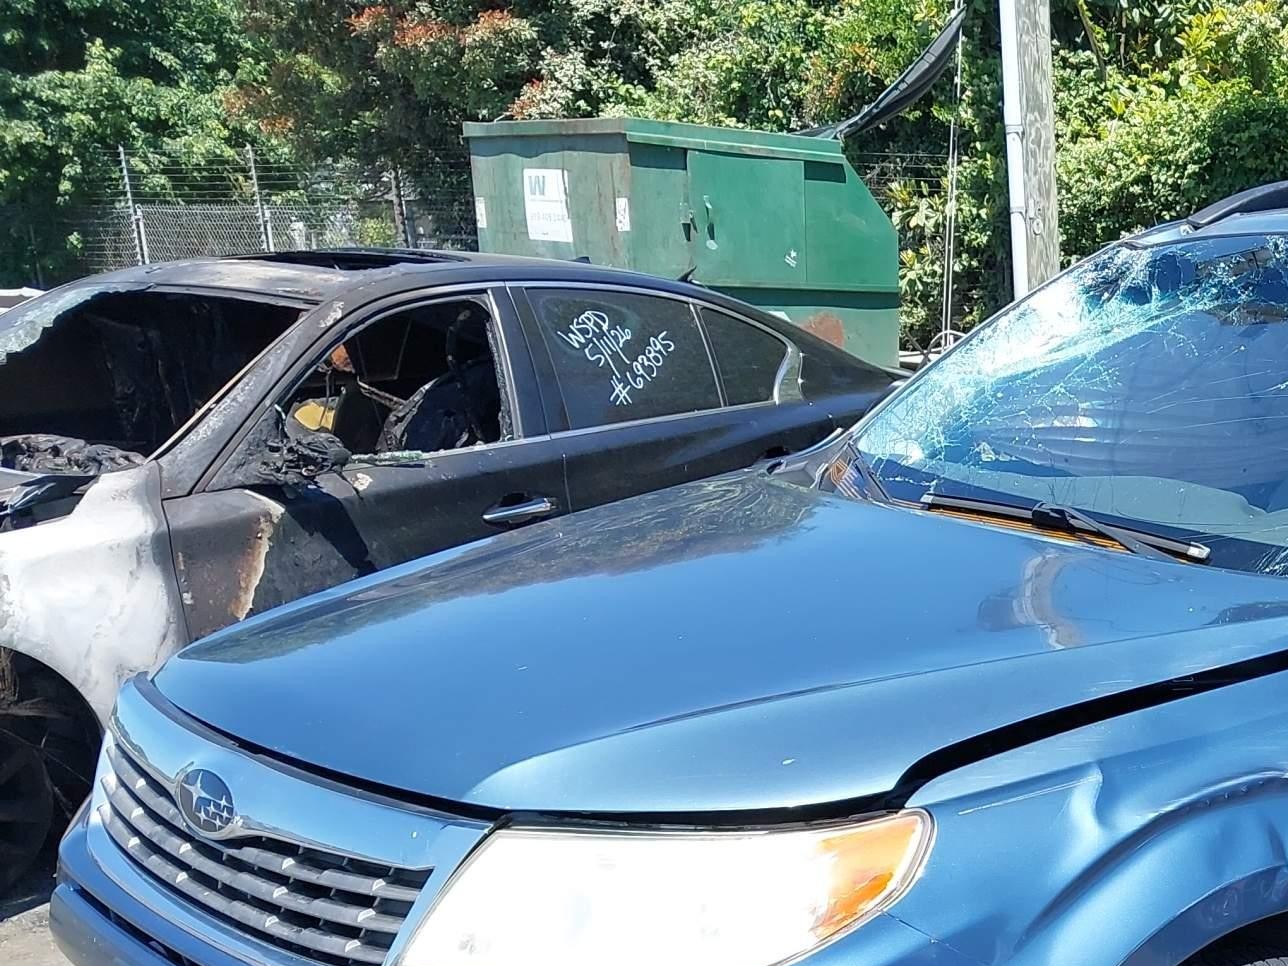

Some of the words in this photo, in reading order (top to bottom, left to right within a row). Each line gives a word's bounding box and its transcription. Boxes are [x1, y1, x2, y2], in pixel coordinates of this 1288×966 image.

[556, 310, 609, 349] WSPD
[584, 325, 632, 378] 5/11/26
[609, 330, 675, 406] #693895
